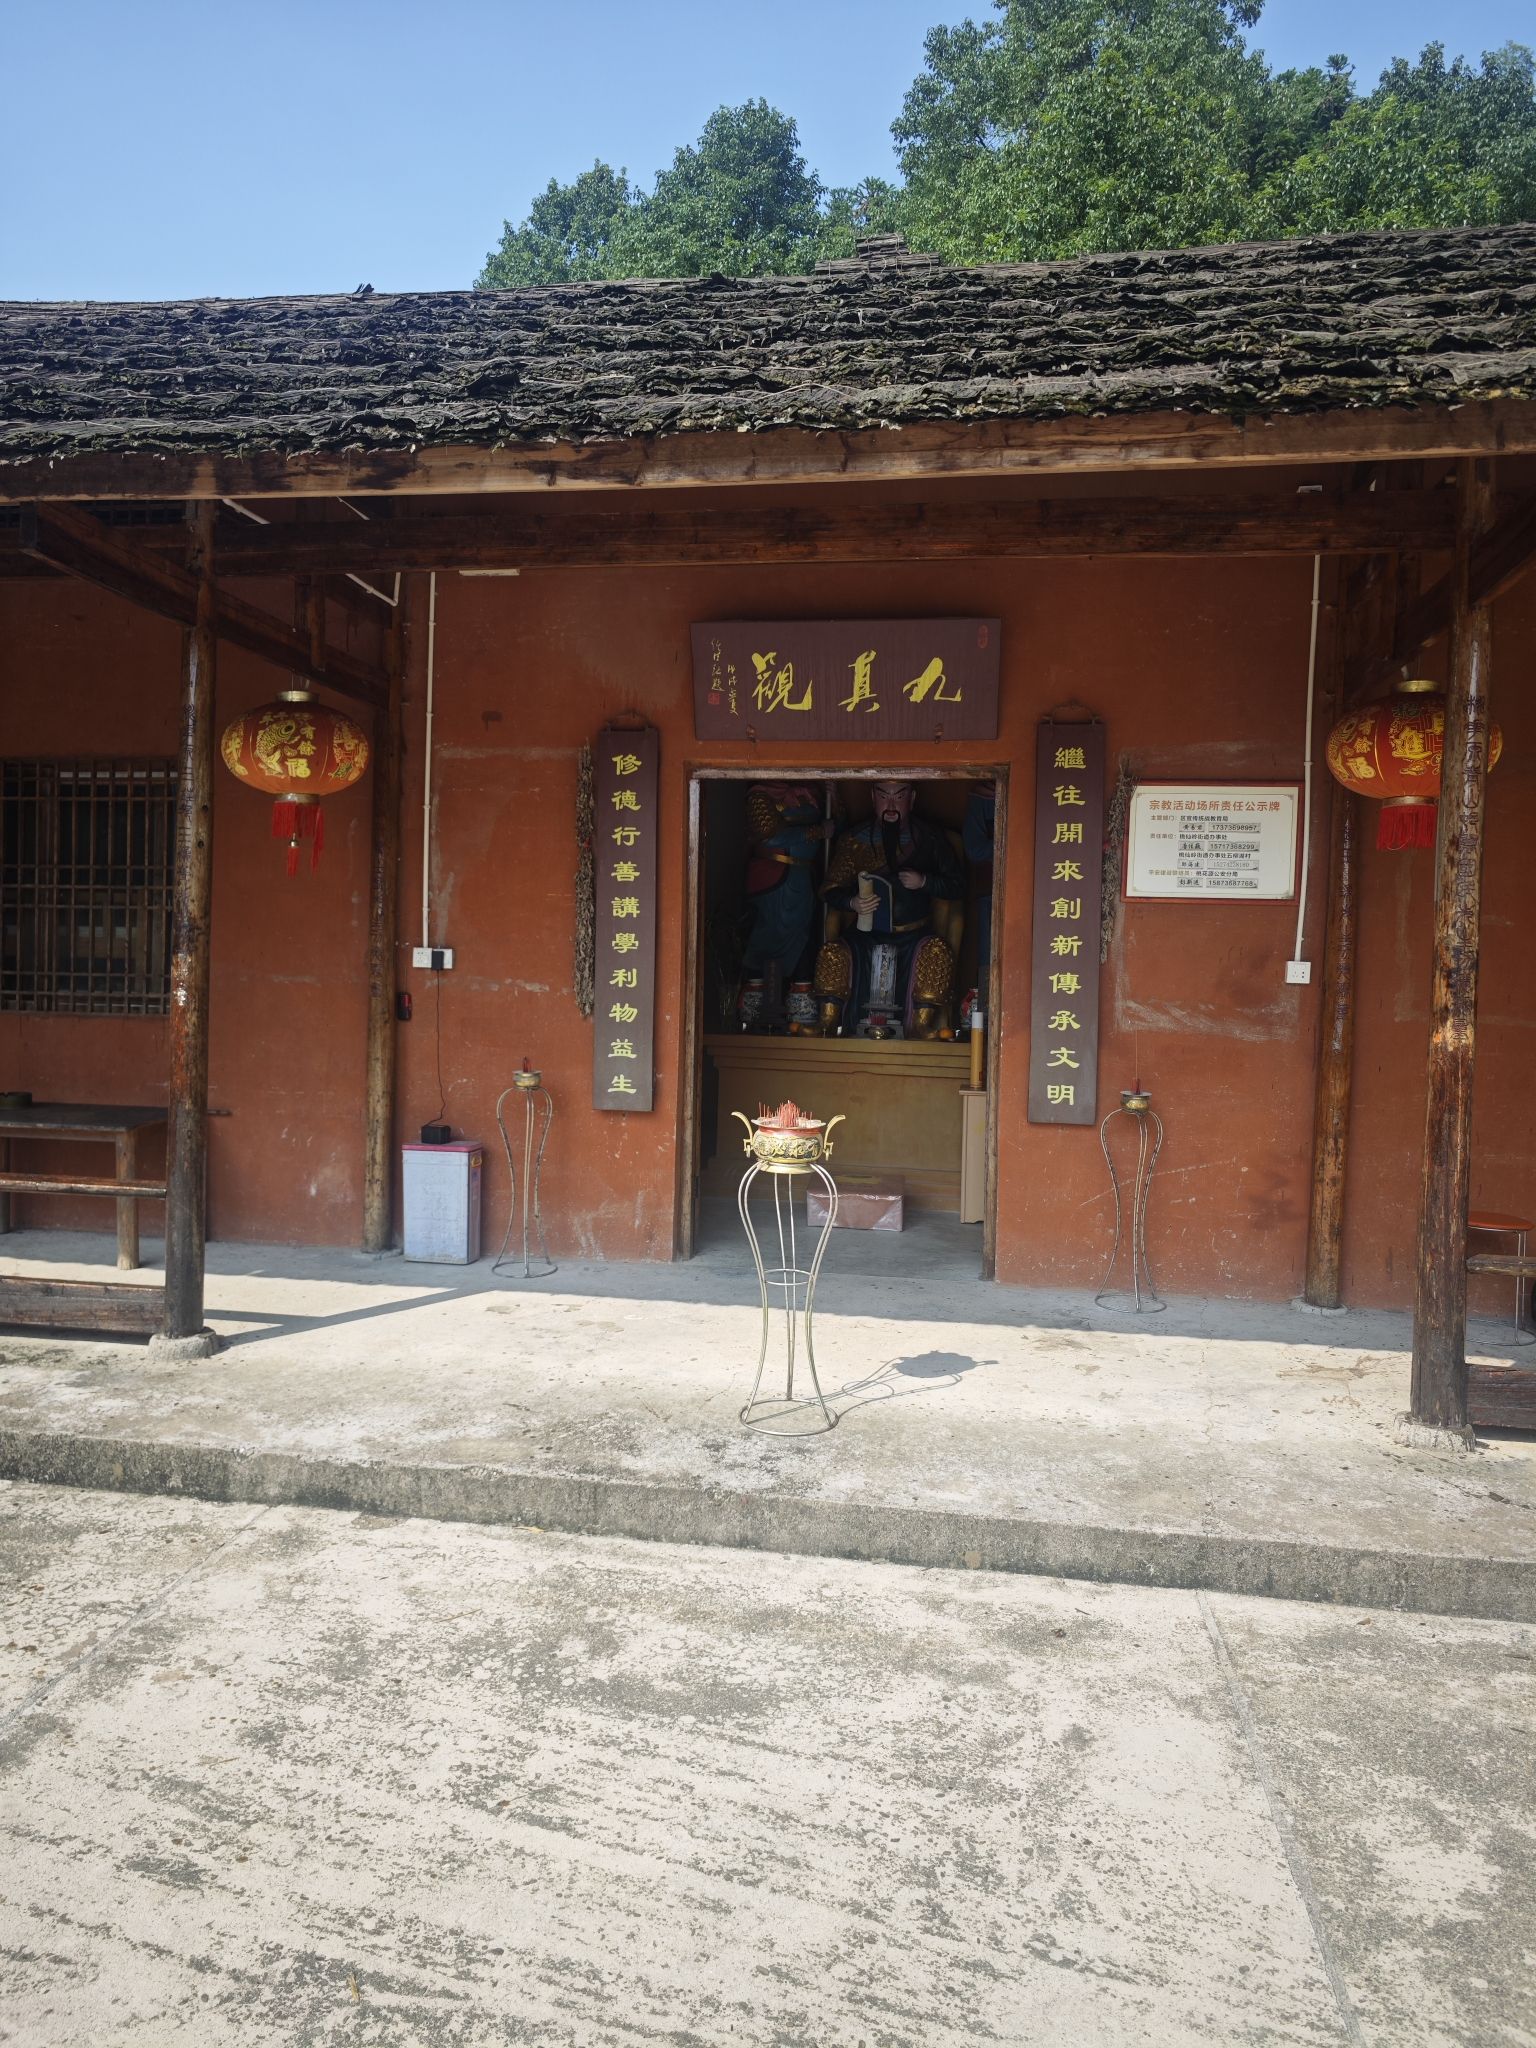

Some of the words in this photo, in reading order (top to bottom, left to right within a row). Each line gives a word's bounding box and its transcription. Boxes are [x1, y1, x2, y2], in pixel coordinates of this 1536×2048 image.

[607, 753, 642, 1095] 修德行善講學利物益生
[1046, 746, 1087, 1106] 繼往開來創新傳承文明
[1148, 799, 1281, 812] 宗教活动场所责任公示牌
